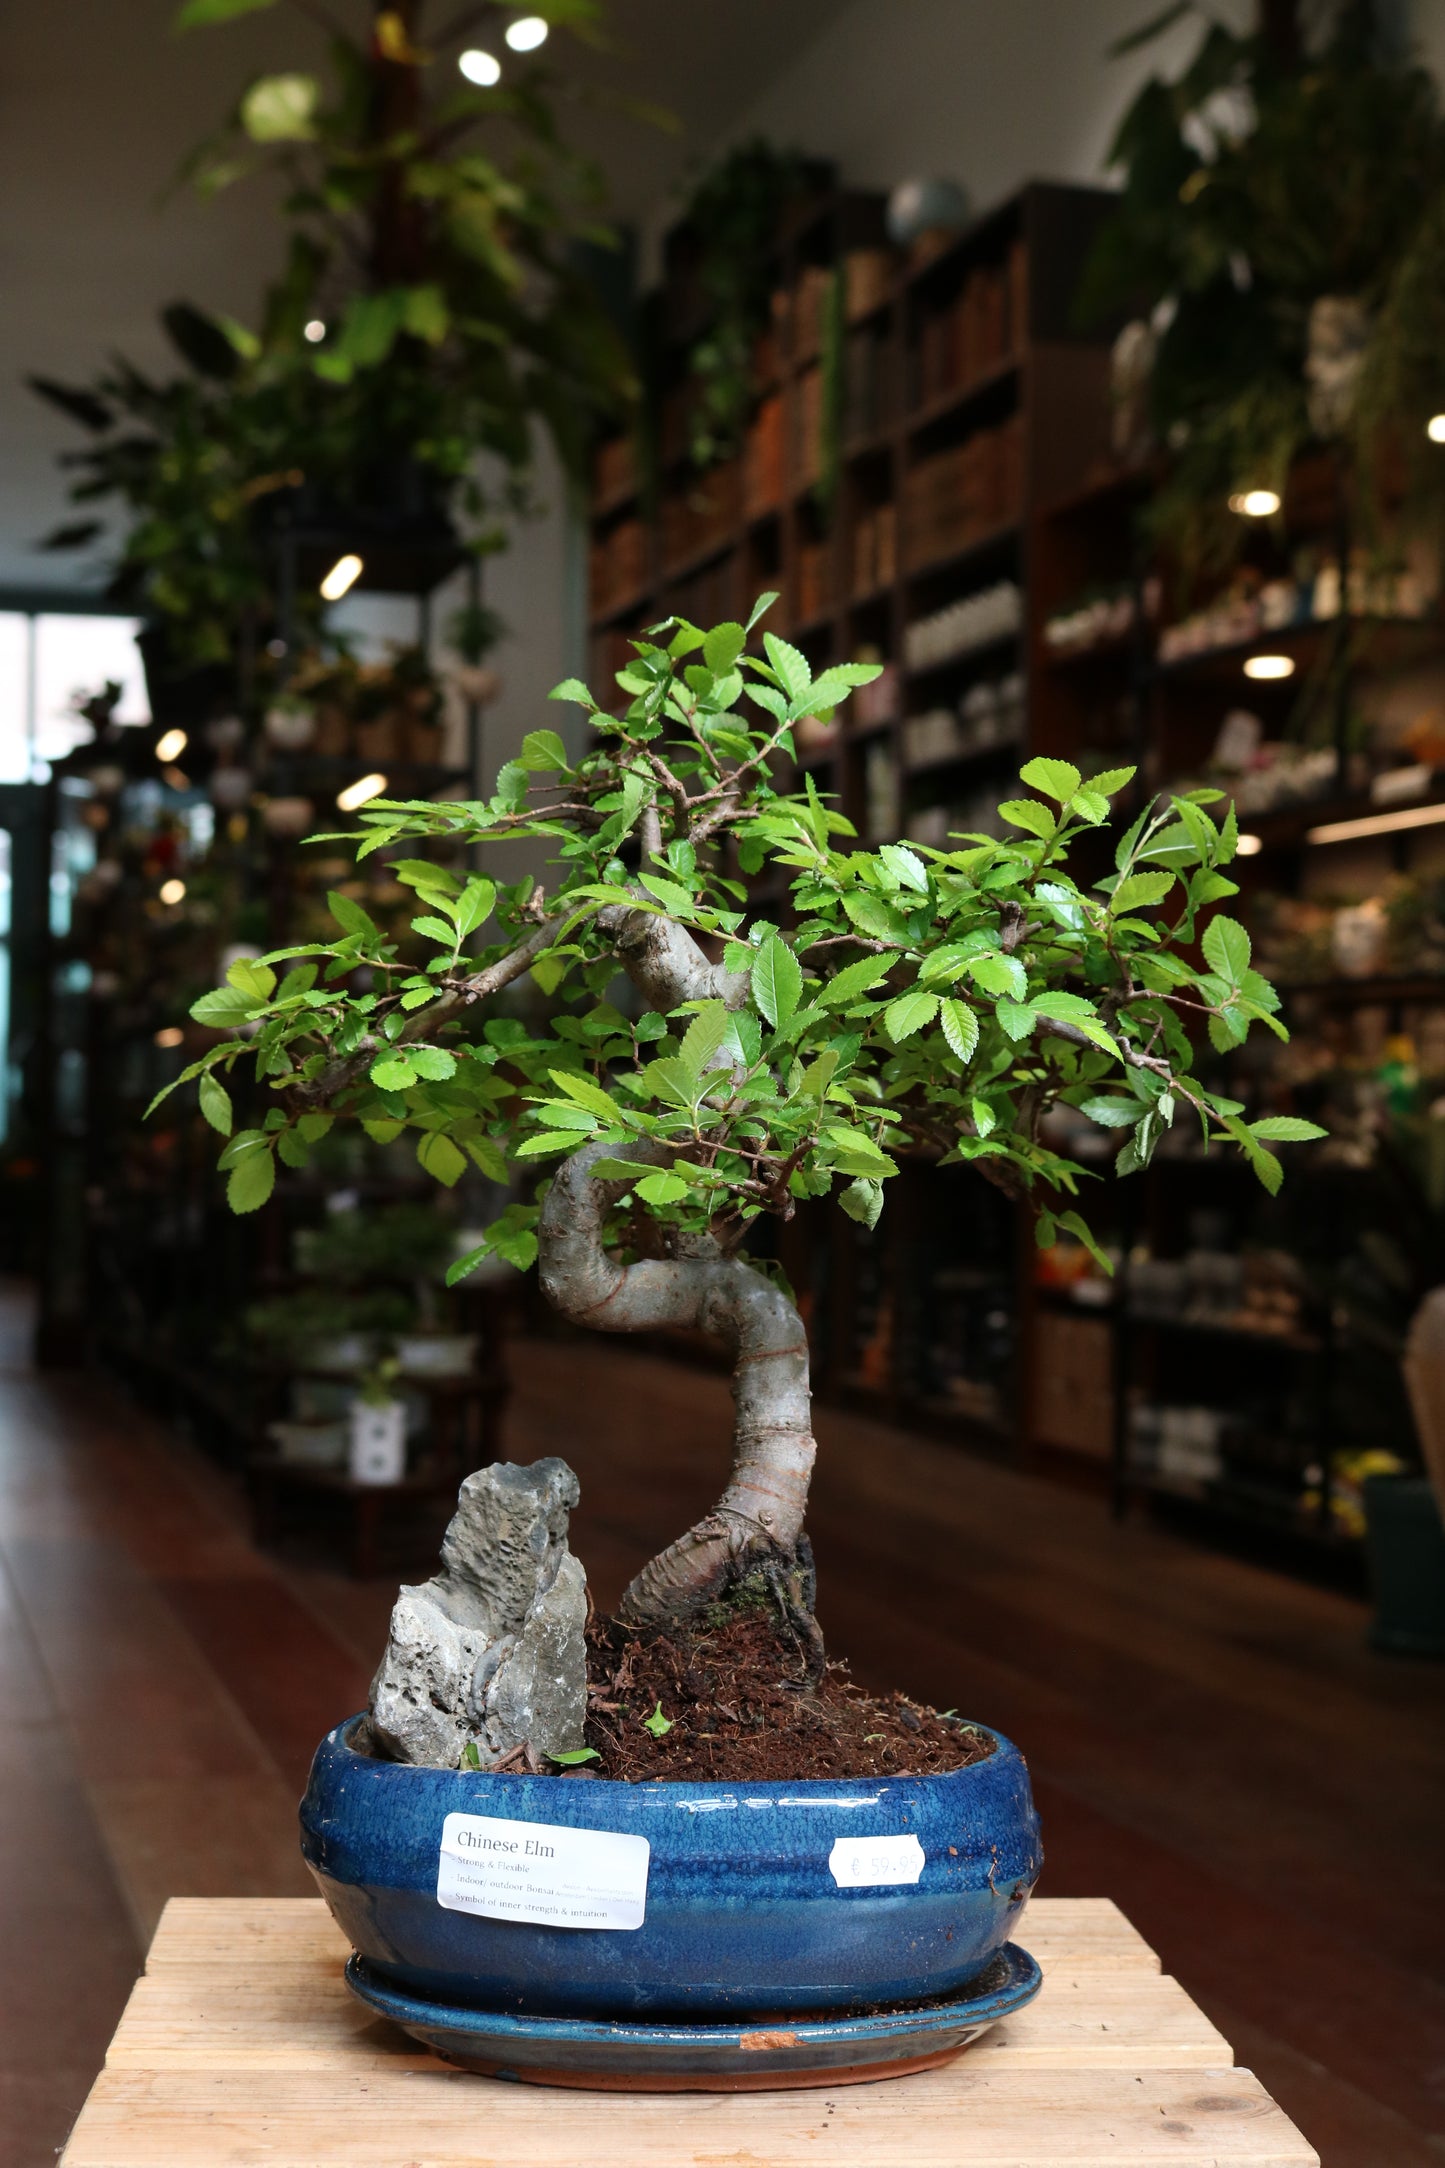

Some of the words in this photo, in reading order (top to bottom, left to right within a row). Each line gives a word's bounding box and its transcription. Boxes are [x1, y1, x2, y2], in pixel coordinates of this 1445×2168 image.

[457, 1831, 519, 1853] Chinese
[525, 1840, 554, 1858] Elm
[457, 1856, 485, 1869] Strong
[487, 1860, 494, 1869] &
[497, 1861, 530, 1873] Flexible
[850, 1857, 861, 1877] €
[871, 1854, 918, 1877] 59.95
[457, 1873, 487, 1887] Indoor/
[490, 1879, 523, 1891] outdoor
[526, 1883, 554, 1895] Bonsai
[455, 1891, 486, 1905] Symbol
[488, 1897, 497, 1907] of
[499, 1900, 521, 1910] inner
[523, 1903, 558, 1916] strength
[561, 1908, 568, 1916] &
[570, 1909, 608, 1919] intuition
